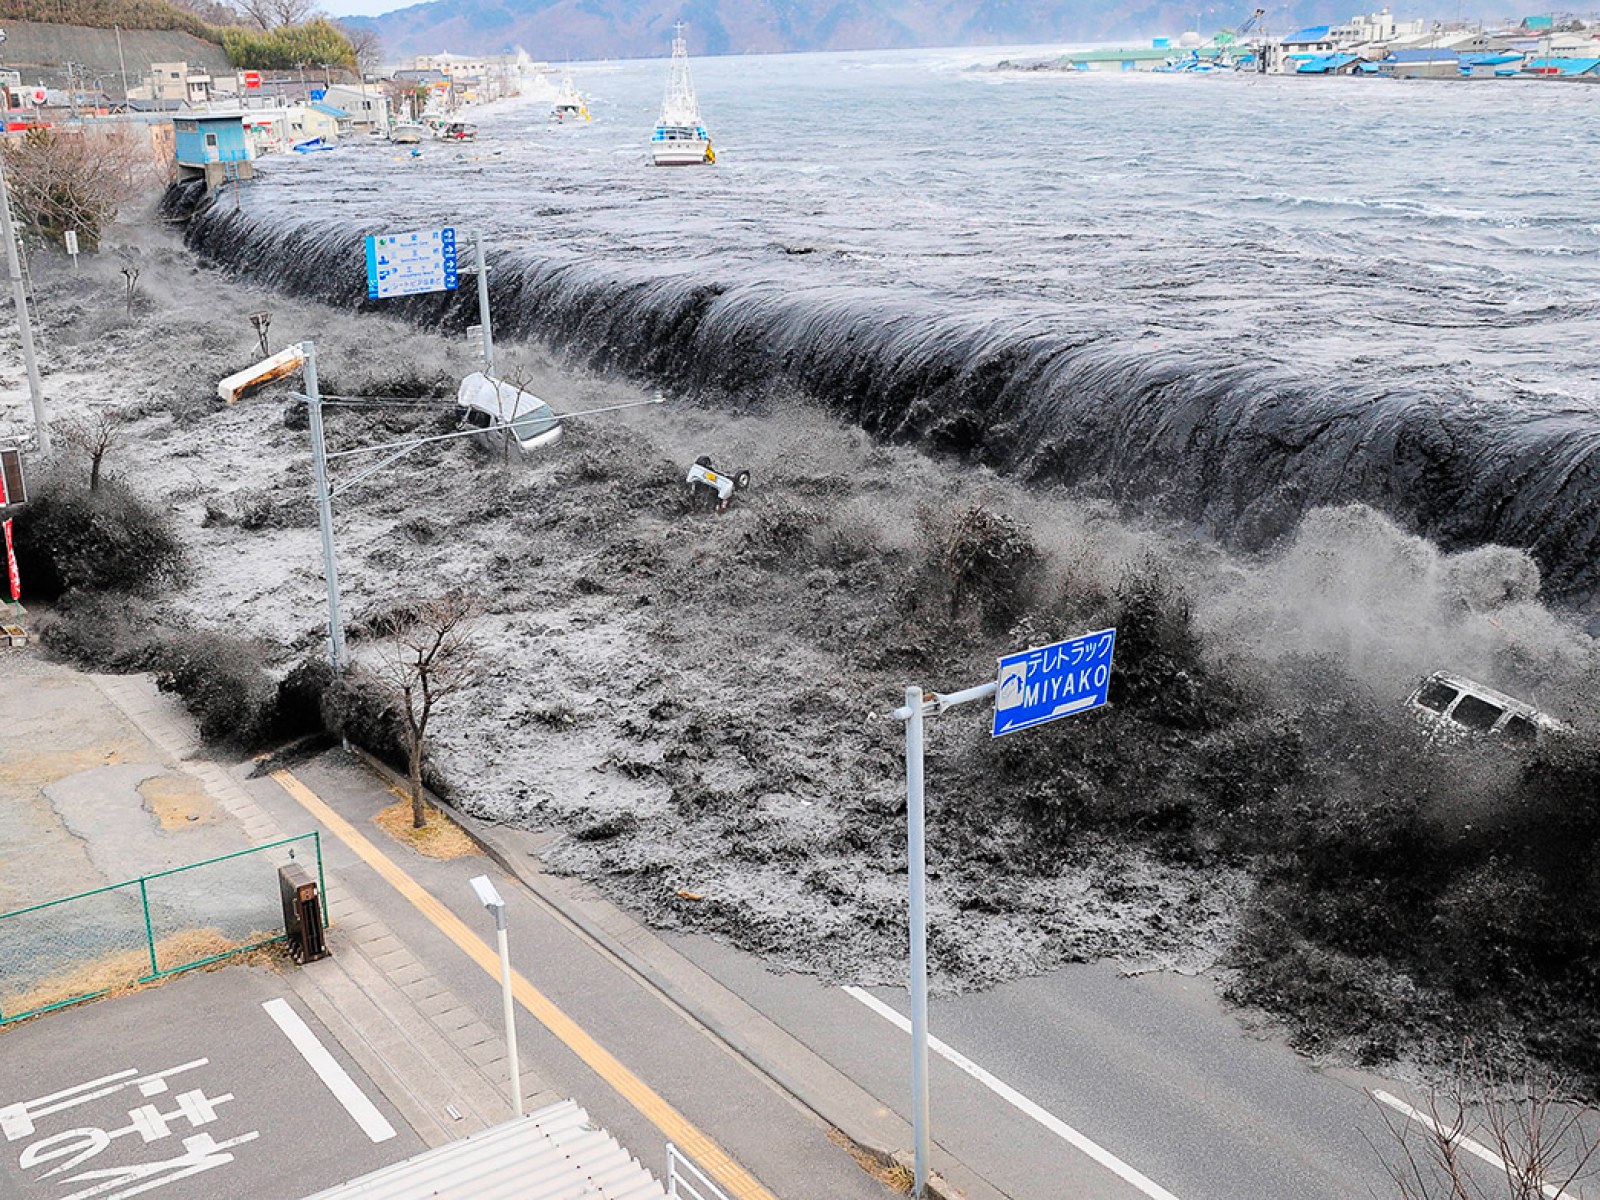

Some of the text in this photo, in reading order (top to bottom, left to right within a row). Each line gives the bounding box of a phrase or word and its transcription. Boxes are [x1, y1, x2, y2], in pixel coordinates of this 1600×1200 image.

[1028, 634, 1112, 677] テレトラック
[1023, 664, 1108, 708] MIYAKO
